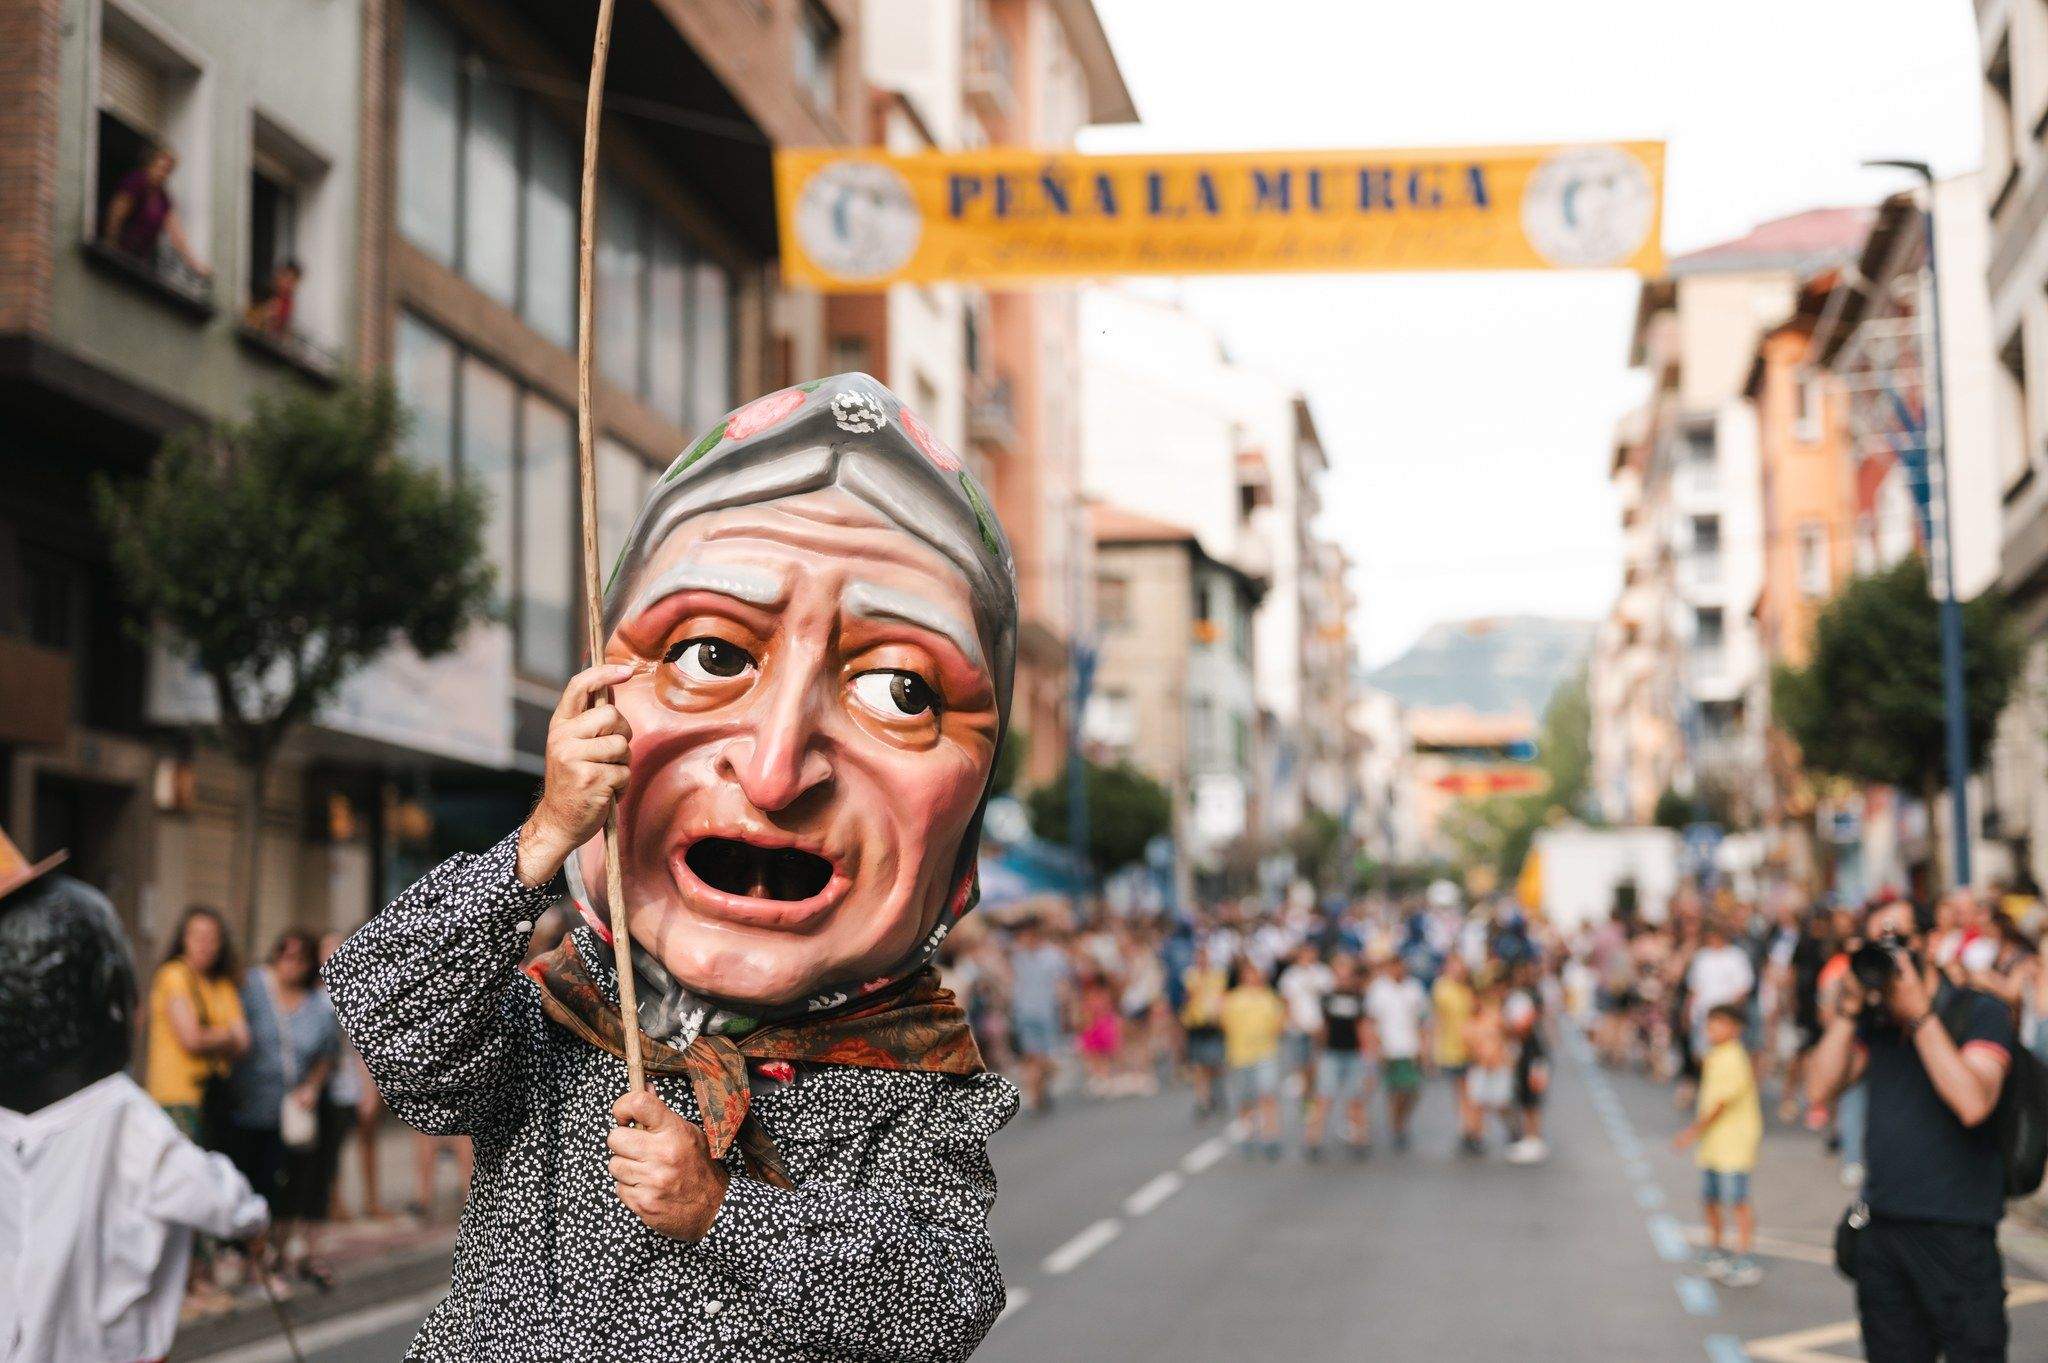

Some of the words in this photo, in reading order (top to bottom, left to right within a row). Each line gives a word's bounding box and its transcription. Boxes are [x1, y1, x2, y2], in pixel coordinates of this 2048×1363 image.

[946, 160, 1118, 218] PEÑA
[1145, 169, 1222, 216] LA
[1251, 162, 1492, 213] MURGA
